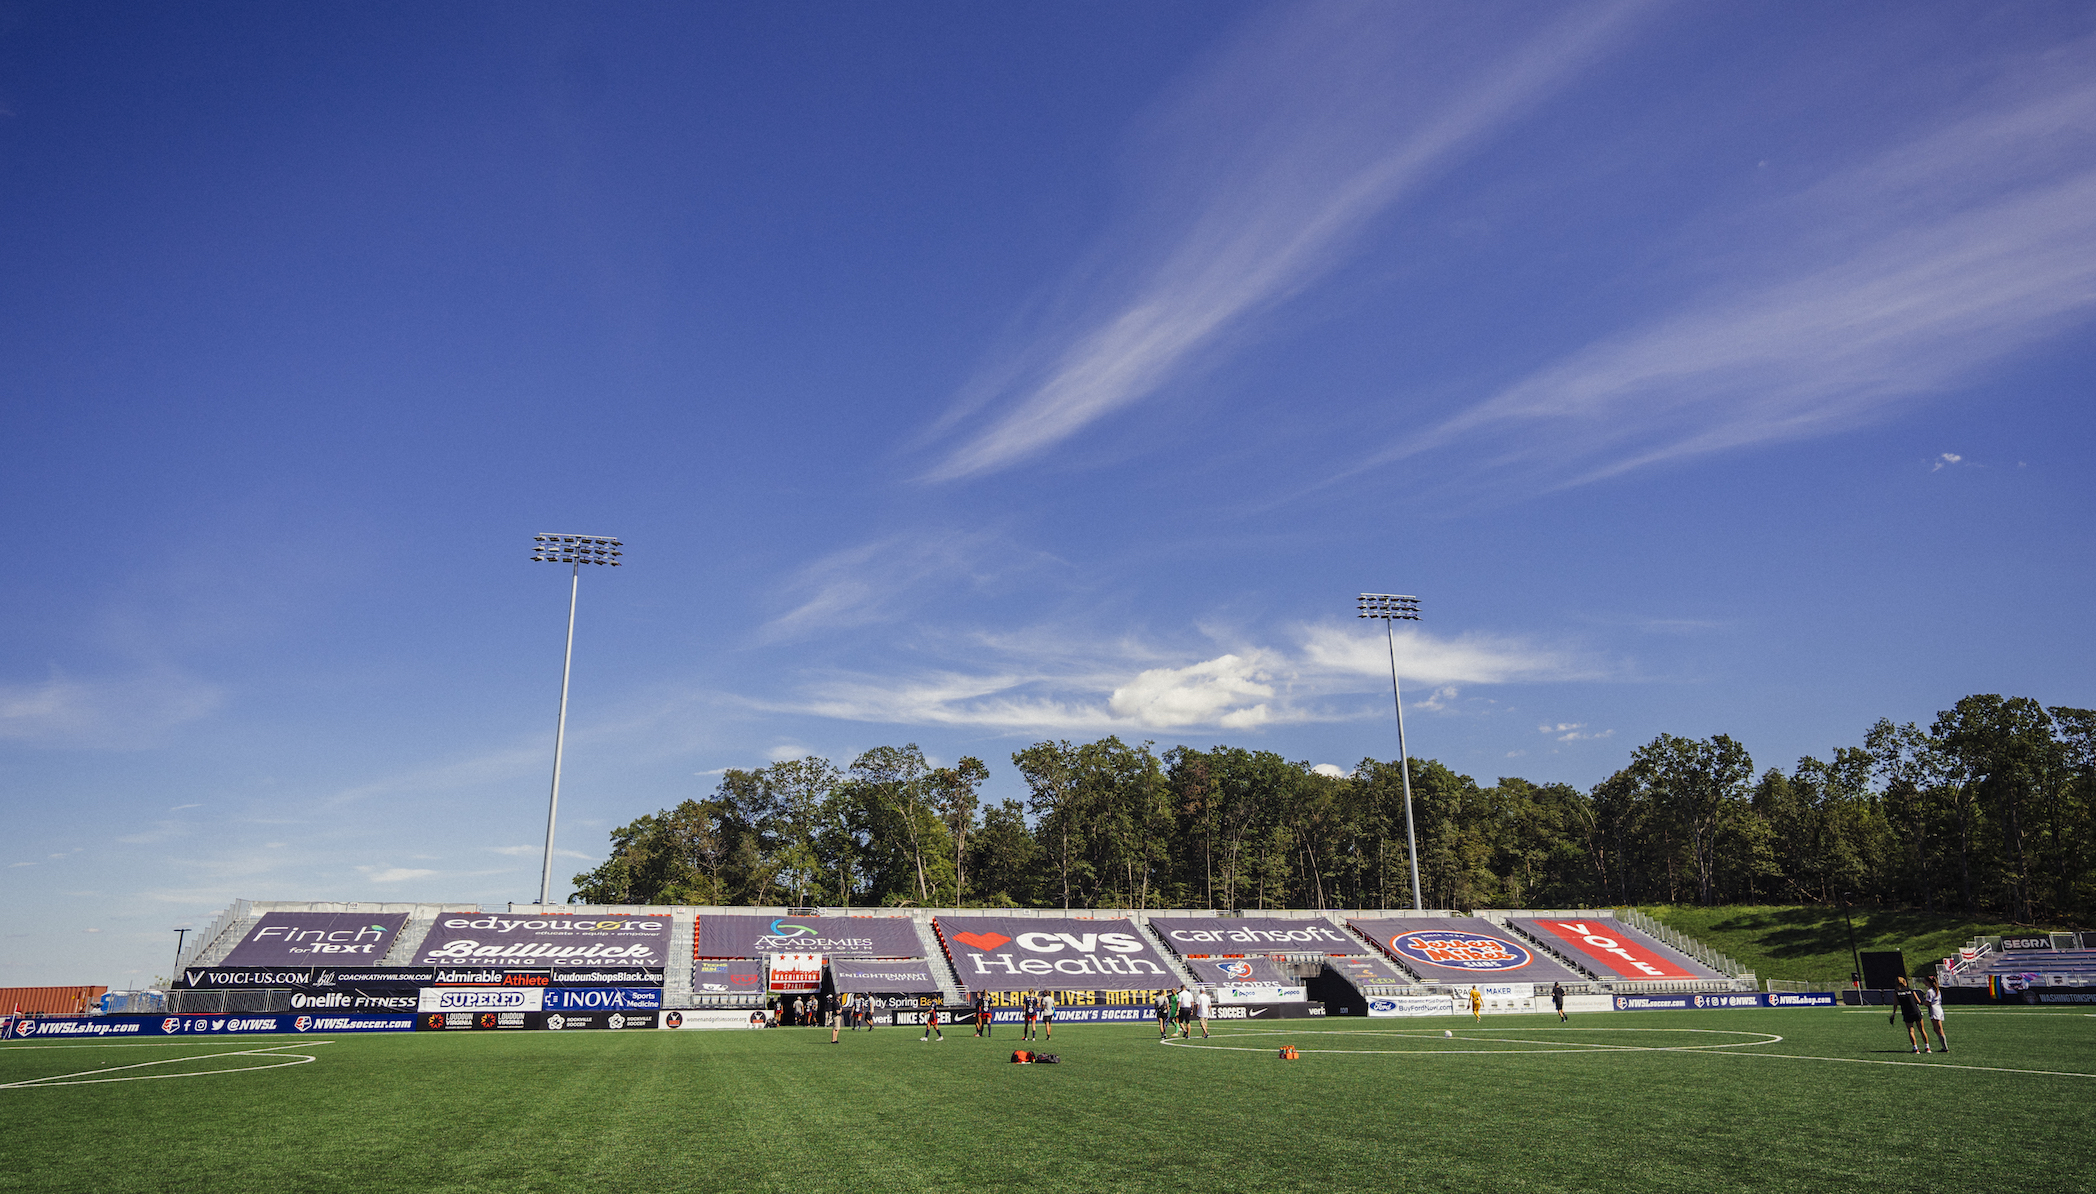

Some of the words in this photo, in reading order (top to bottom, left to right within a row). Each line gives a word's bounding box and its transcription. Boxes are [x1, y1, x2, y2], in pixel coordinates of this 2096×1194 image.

[253, 926, 383, 942] Finch
[1170, 926, 1347, 942] carahsoft
[754, 936, 873, 947] ACADEMIES
[1016, 932, 1144, 952] CVS
[1408, 938, 1505, 951] Jersey
[2003, 939, 2050, 949] SEGRA
[310, 942, 376, 954] Text
[1557, 923, 1665, 975] VOTE
[423, 957, 536, 965] CLOTHING
[554, 957, 659, 965] COMPANY
[967, 953, 1167, 975] Health
[208, 972, 310, 984] VOICI-US.COM
[338, 973, 433, 981] COACHKATHYWILSON.COM
[435, 970, 502, 982] Admirable
[503, 974, 549, 986] Athlete
[553, 972, 663, 983] LoudounShopsBlack.com
[632, 992, 655, 1000] Sports
[1486, 987, 1512, 995] MAKER
[291, 992, 351, 1008] Onelife
[354, 996, 418, 1008] FITNESS
[440, 991, 525, 1008] SUPERFD
[563, 991, 624, 1007] INOVA
[627, 1000, 659, 1008] Medicine
[889, 996, 919, 1009] Spring
[1628, 998, 1686, 1008] NWSLsoccer.com
[1729, 996, 1758, 1006] @NWSL
[1779, 995, 1832, 1006] NWSLshop.com
[1373, 1001, 1393, 1010] Ford
[445, 1012, 474, 1020] LOUDOUN
[497, 1012, 526, 1020] LOUDOUN
[897, 1012, 917, 1025] NIKE
[1101, 1009, 1139, 1019] SOCCER
[1218, 1007, 1247, 1018] SOCCER
[36, 1021, 140, 1035] NWSLshop.com
[227, 1018, 278, 1031] @NWSL
[313, 1018, 412, 1030] NWSLsoccer.com
